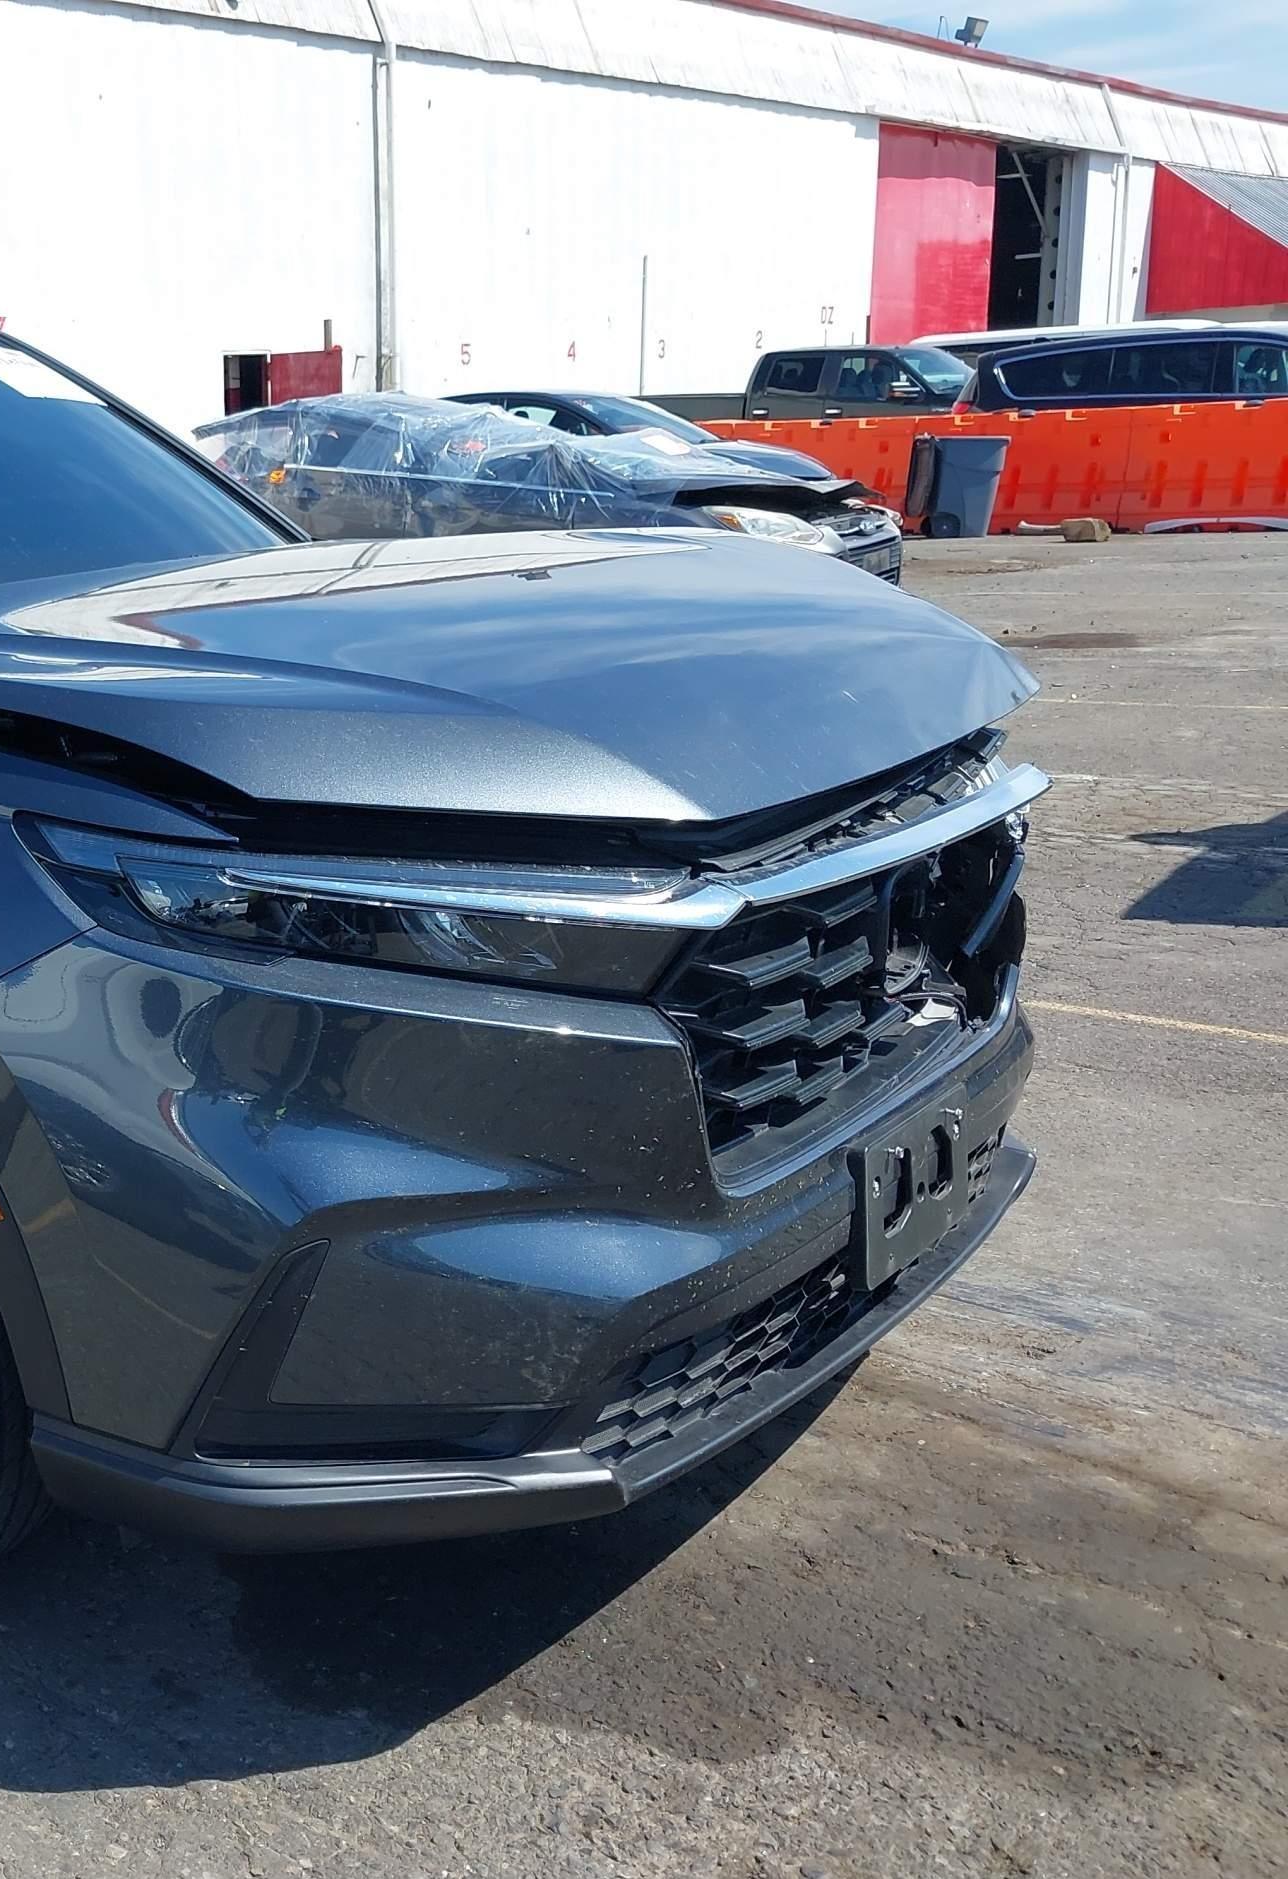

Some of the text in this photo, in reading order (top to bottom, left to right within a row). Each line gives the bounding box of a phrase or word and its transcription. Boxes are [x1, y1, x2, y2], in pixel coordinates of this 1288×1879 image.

[657, 339, 666, 360] 3
[755, 330, 763, 350] 2
[460, 343, 472, 366] 5
[567, 340, 577, 362] 4
